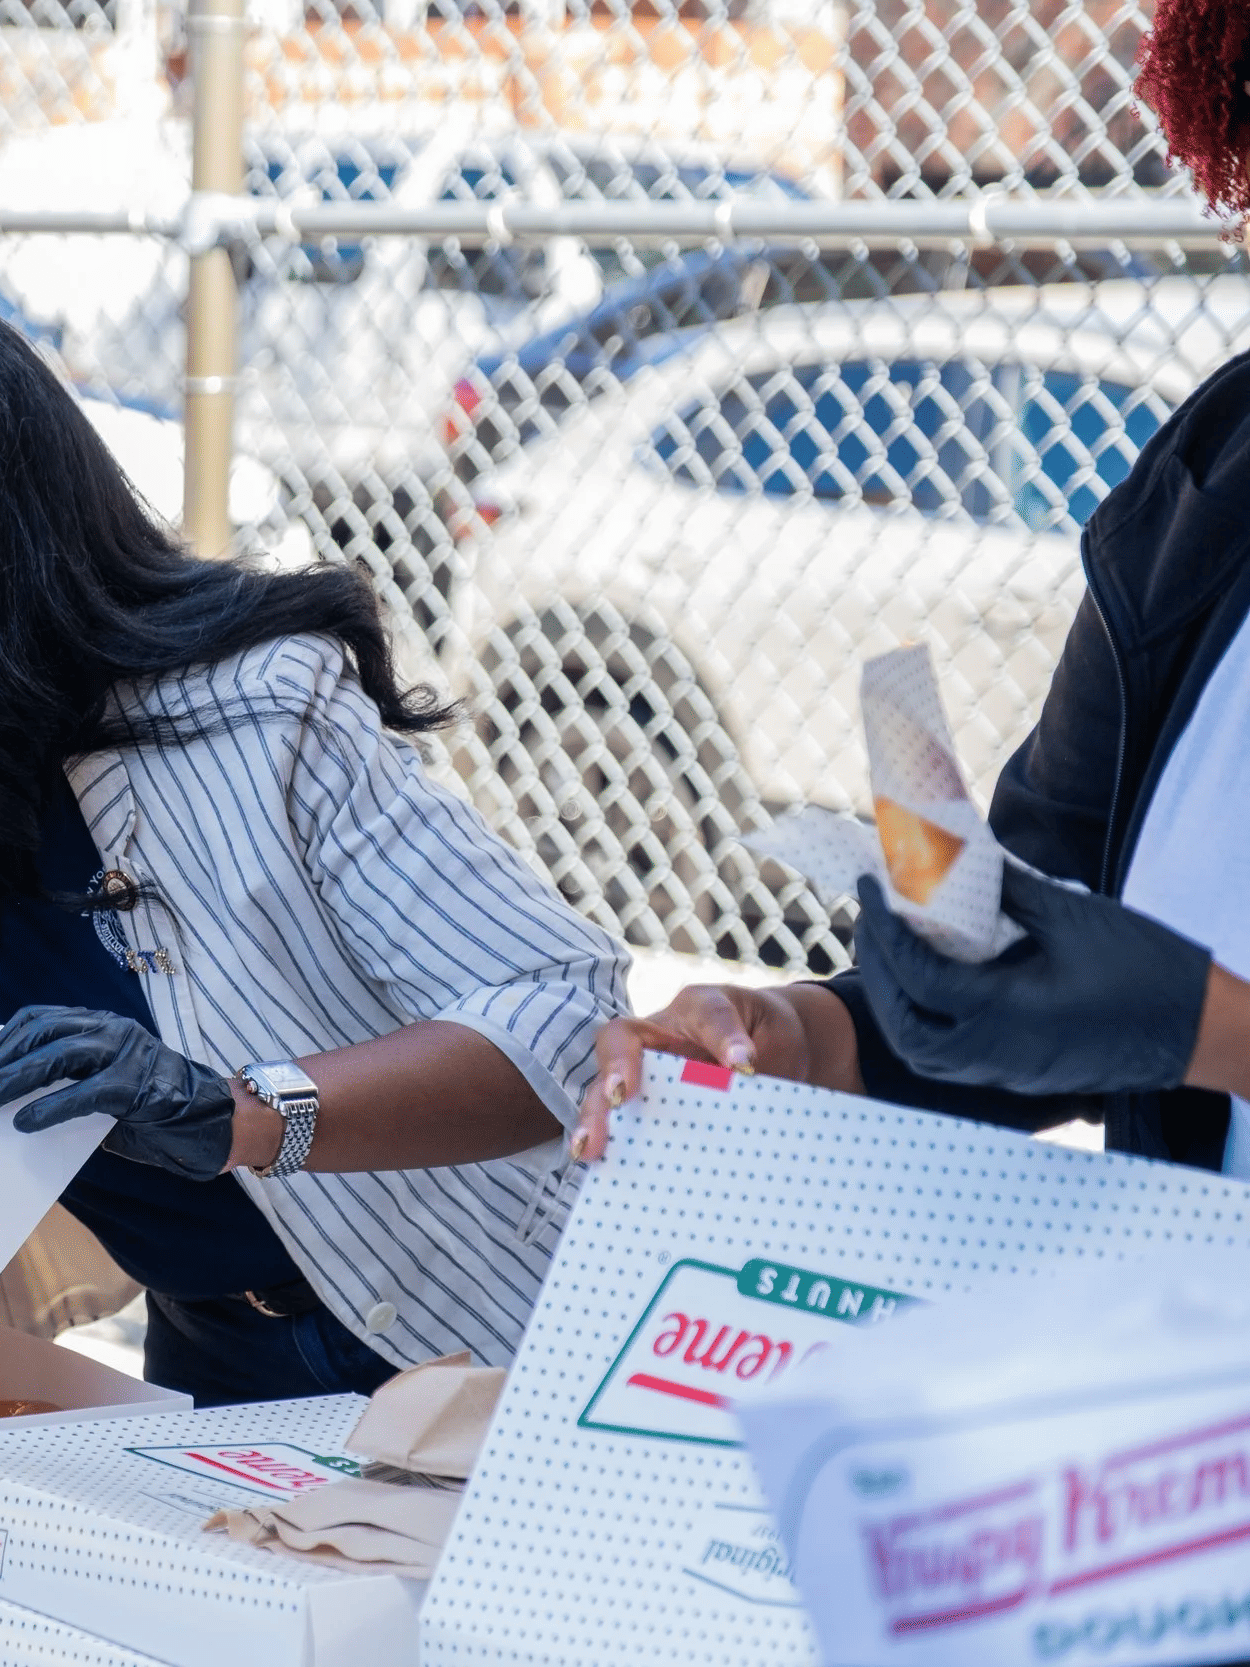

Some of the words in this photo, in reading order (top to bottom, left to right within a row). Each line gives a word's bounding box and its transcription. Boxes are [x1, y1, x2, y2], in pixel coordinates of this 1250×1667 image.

[640, 1312, 798, 1396] reme
[188, 1450, 328, 1490] reme
[702, 1538, 796, 1584] riginal
